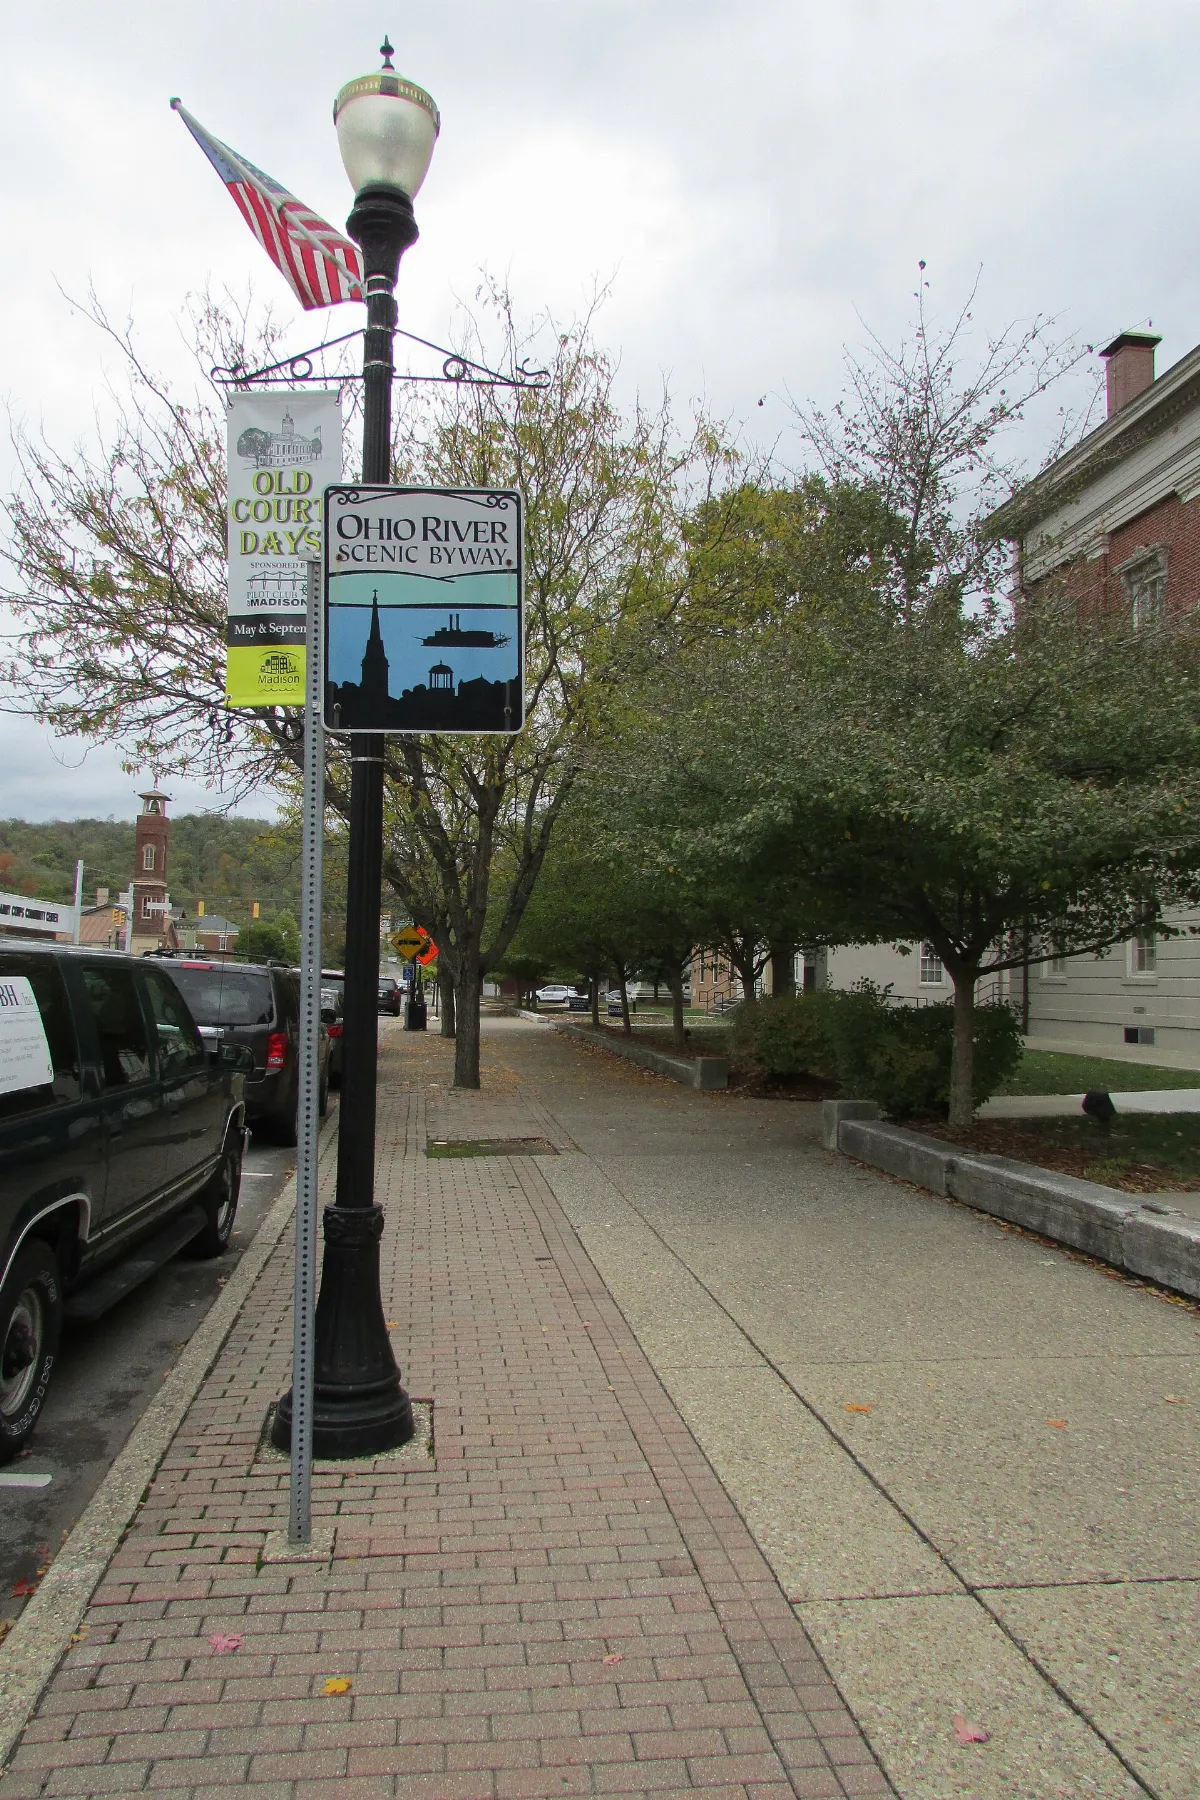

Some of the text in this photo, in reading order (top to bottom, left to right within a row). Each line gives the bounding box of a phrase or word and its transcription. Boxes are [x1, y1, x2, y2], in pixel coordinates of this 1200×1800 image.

[253, 470, 312, 495] OLD
[231, 497, 322, 523] COURT
[240, 525, 322, 555] DAYS
[336, 514, 509, 544] OHIO RIVER
[338, 544, 507, 566] SCENIC BYWAY
[247, 591, 270, 599] PILOT
[234, 624, 256, 638] May
[259, 623, 267, 634] &
[258, 675, 300, 684] Madison
